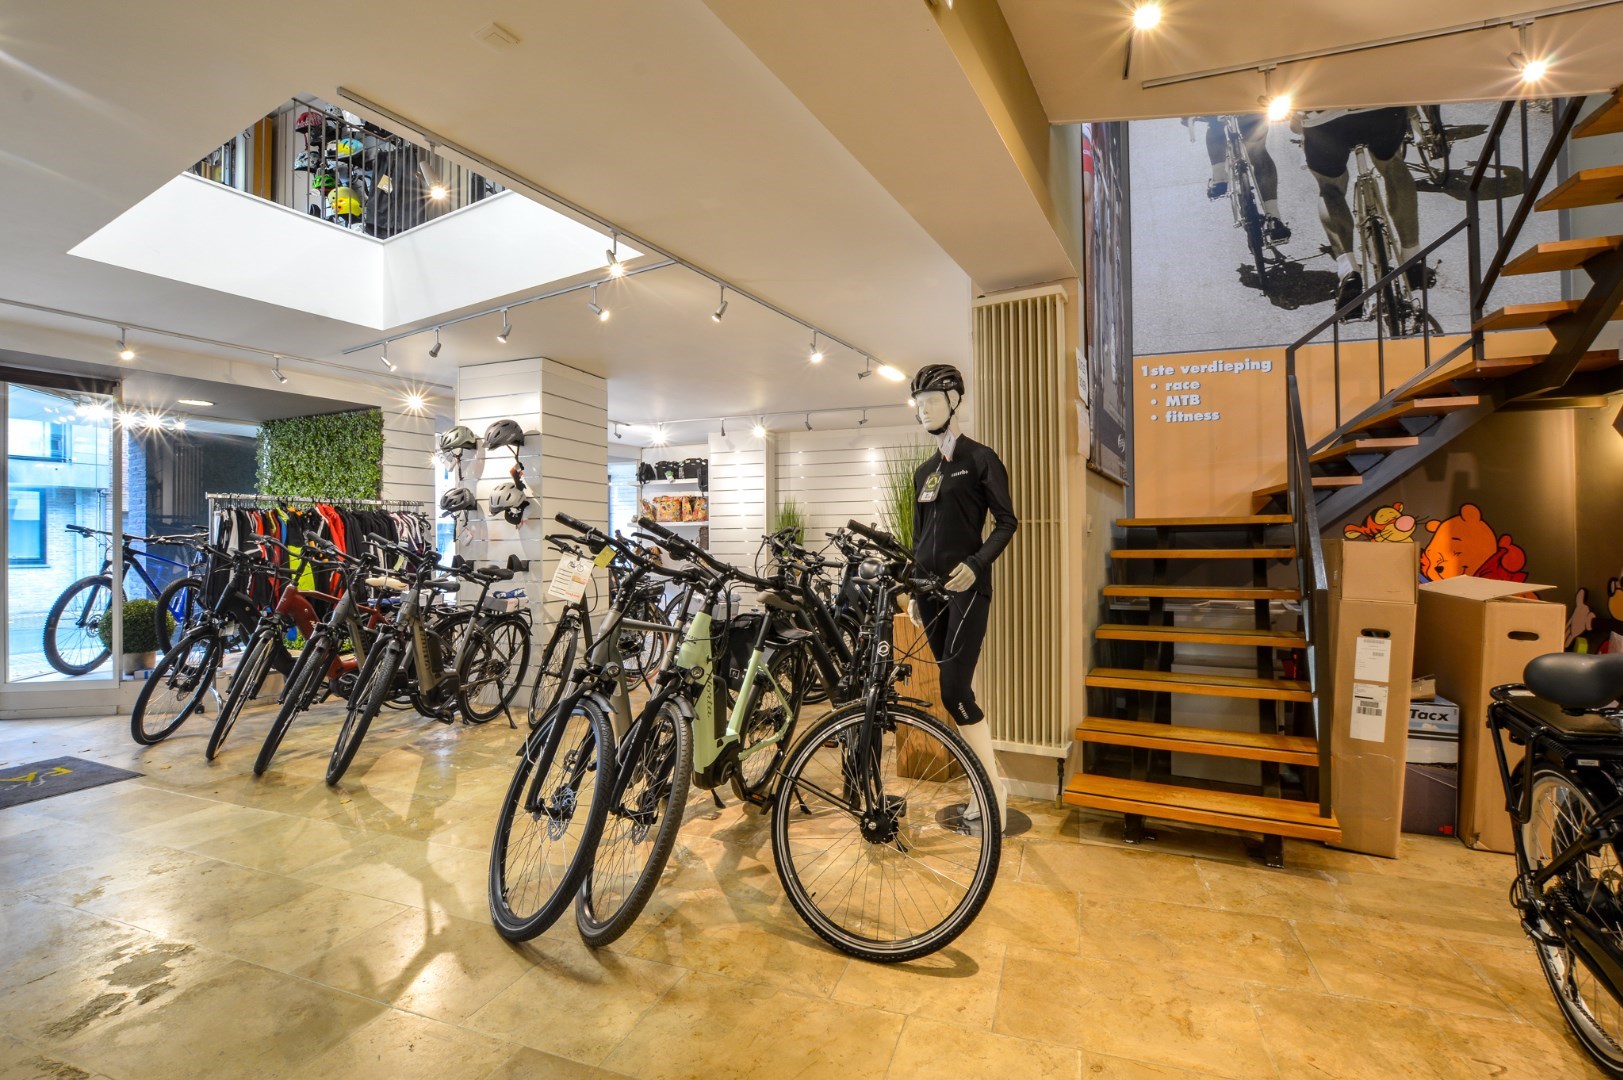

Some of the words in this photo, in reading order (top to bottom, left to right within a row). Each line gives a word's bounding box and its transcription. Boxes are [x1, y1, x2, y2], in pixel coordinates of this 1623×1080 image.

[1141, 365, 1175, 377] 1ste
[1180, 358, 1273, 374] verdieping
[1165, 381, 1201, 391] race
[1165, 394, 1202, 407] MTB
[1165, 410, 1221, 423] fitness
[1409, 709, 1449, 721] Tacx
